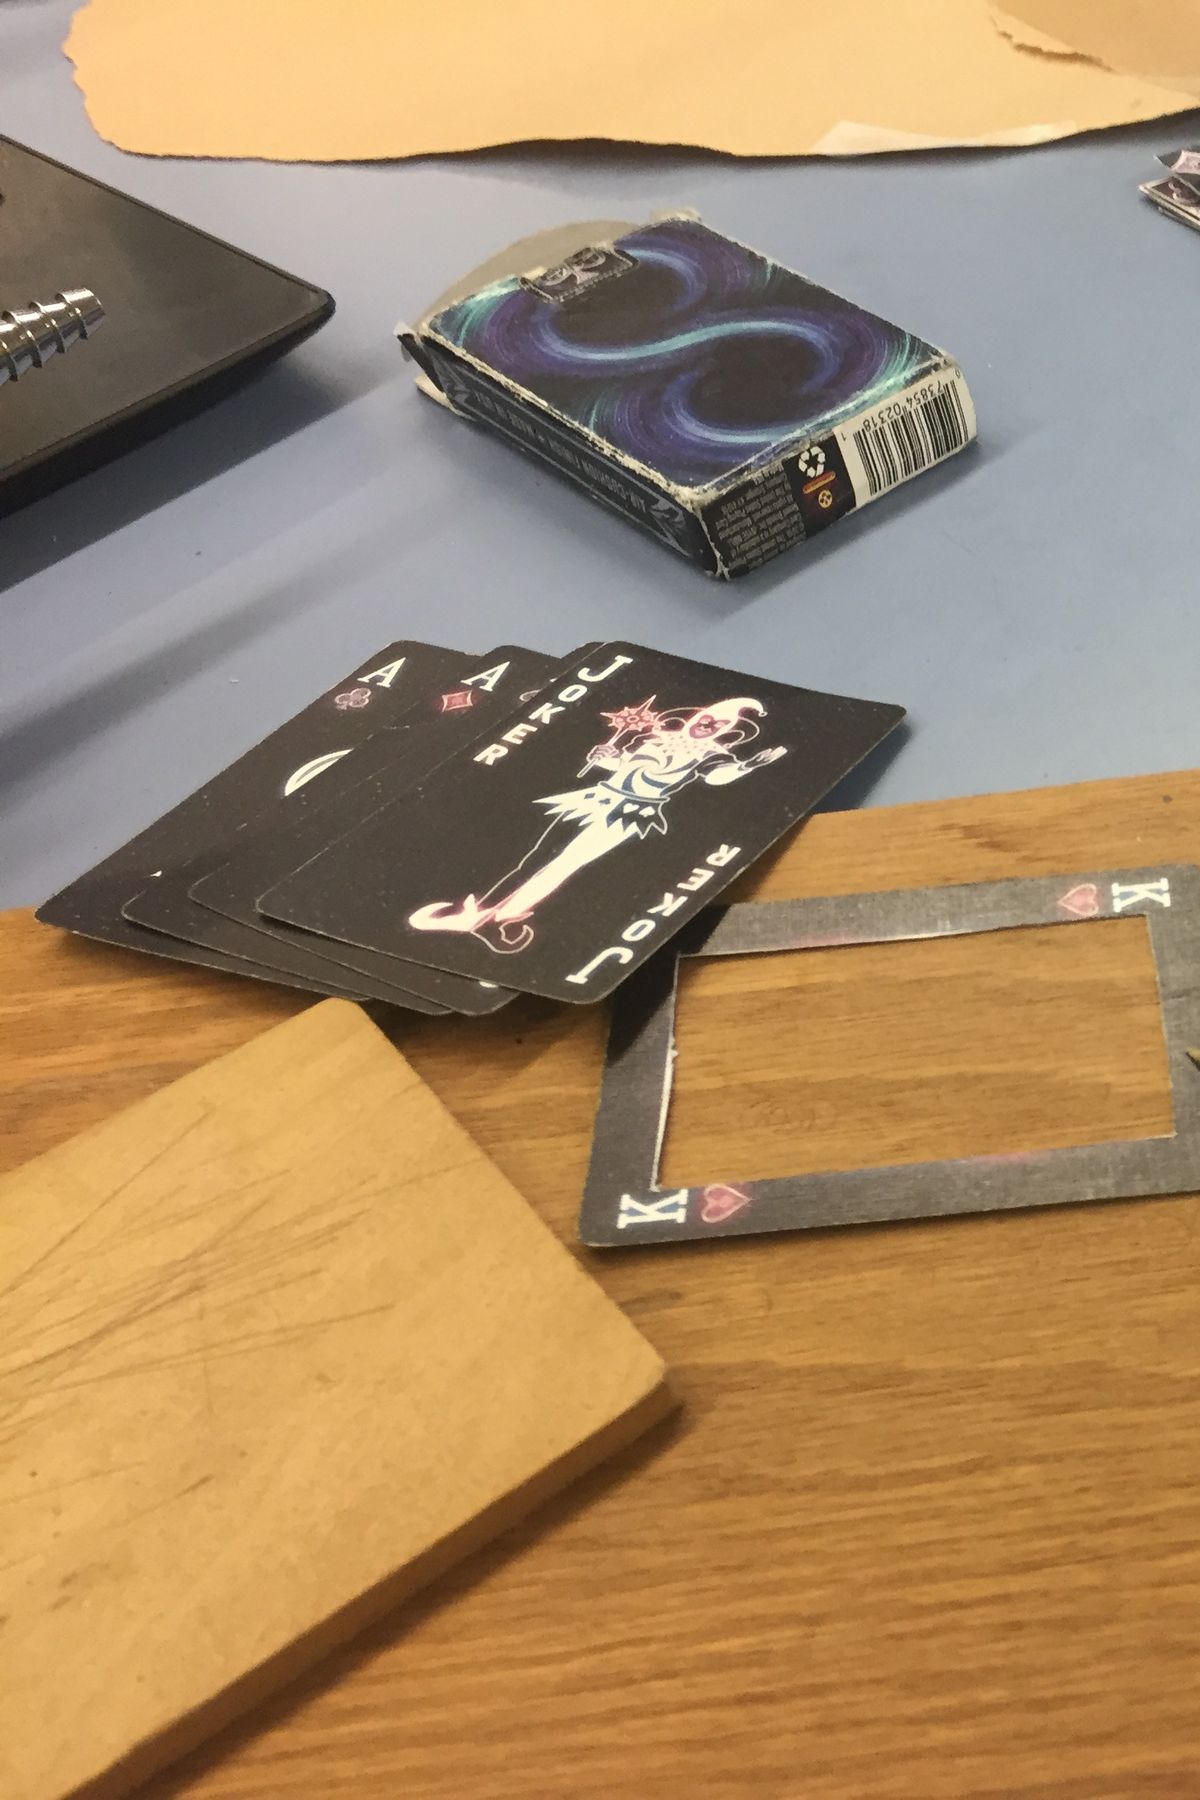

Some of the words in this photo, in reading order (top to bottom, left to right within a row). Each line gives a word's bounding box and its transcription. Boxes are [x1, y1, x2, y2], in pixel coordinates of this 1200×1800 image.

[905, 380, 944, 409] 73854
[862, 402, 901, 432] 02318
[357, 656, 407, 688] A
[460, 660, 511, 692] A
[473, 654, 634, 766] JOKER
[1111, 877, 1171, 913] K
[564, 843, 742, 985] JOKER
[616, 1188, 689, 1230] K
